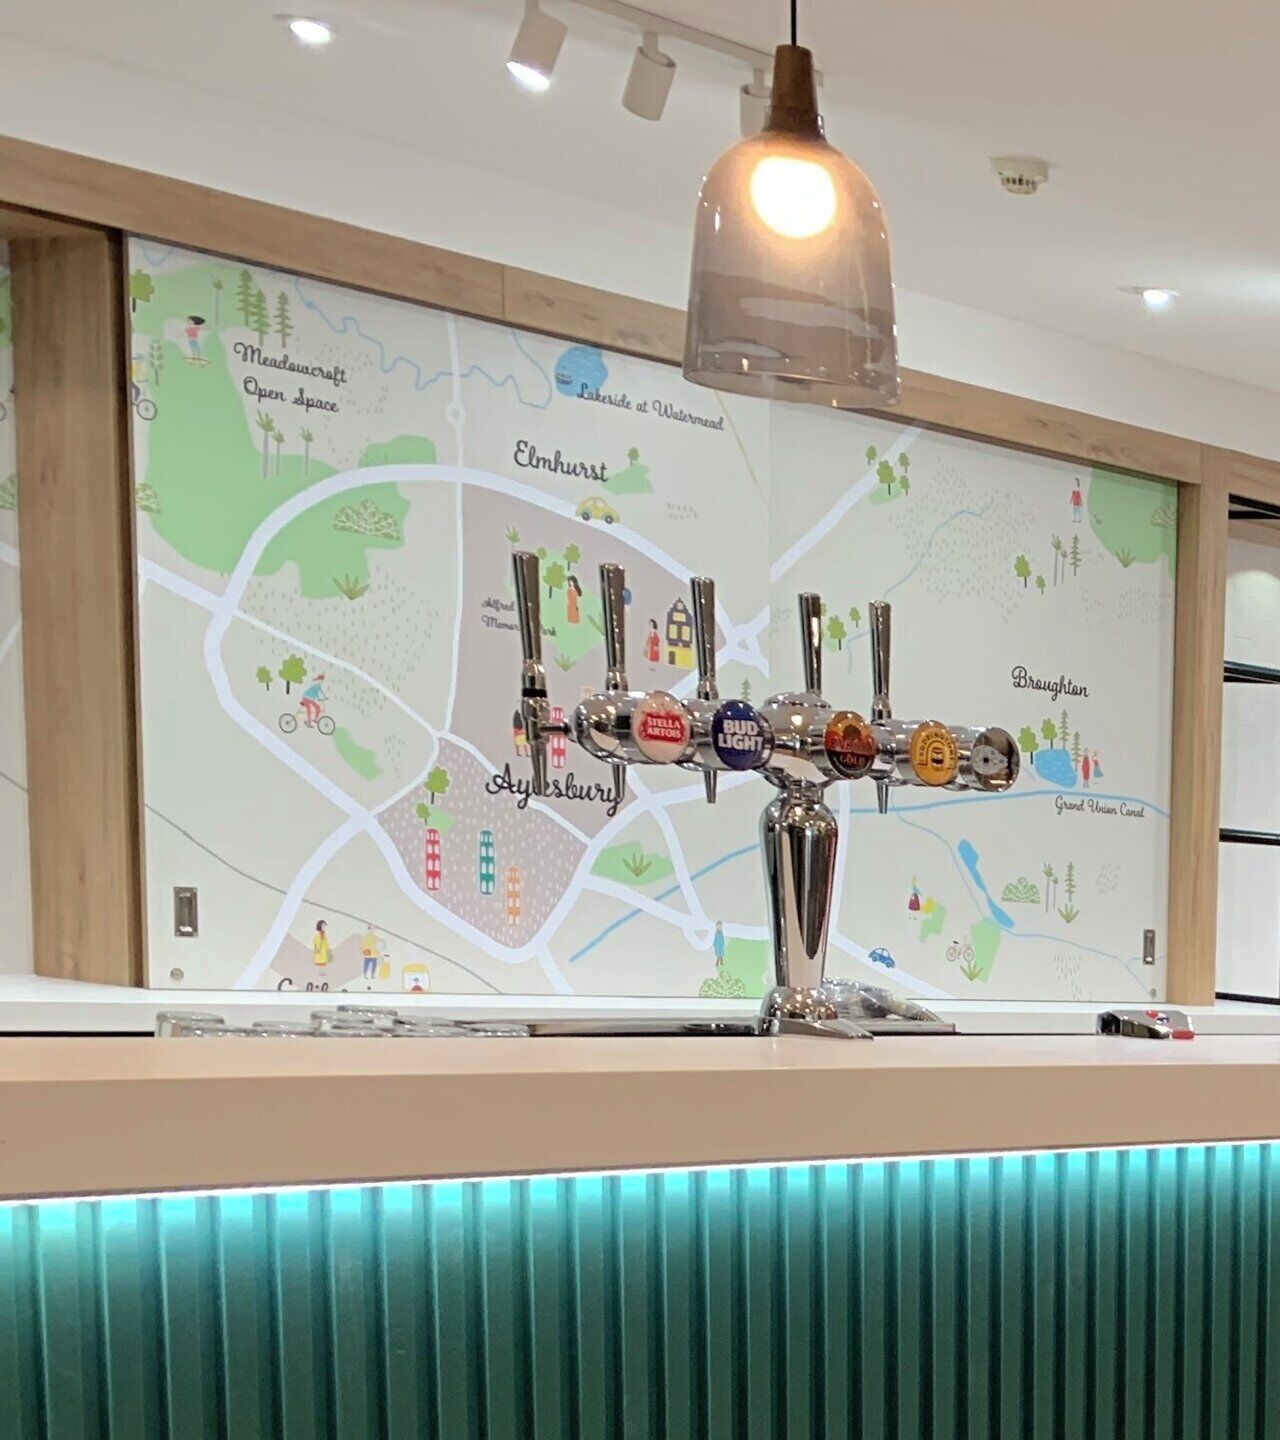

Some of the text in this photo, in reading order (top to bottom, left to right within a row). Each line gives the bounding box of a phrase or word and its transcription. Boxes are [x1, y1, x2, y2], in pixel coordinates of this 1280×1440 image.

[233, 342, 347, 387] Meadowcroft
[243, 376, 339, 413] Open Space
[576, 382, 724, 431] Lakeside at Watermead
[513, 440, 609, 483] Elmhurst
[1011, 665, 1090, 701] Broughton
[646, 717, 681, 729] STELLA
[646, 727, 681, 738] ARTOIS
[723, 720, 758, 736] BUD
[718, 733, 763, 752] LIGHT
[1055, 795, 1146, 819] Grand Union Canal
